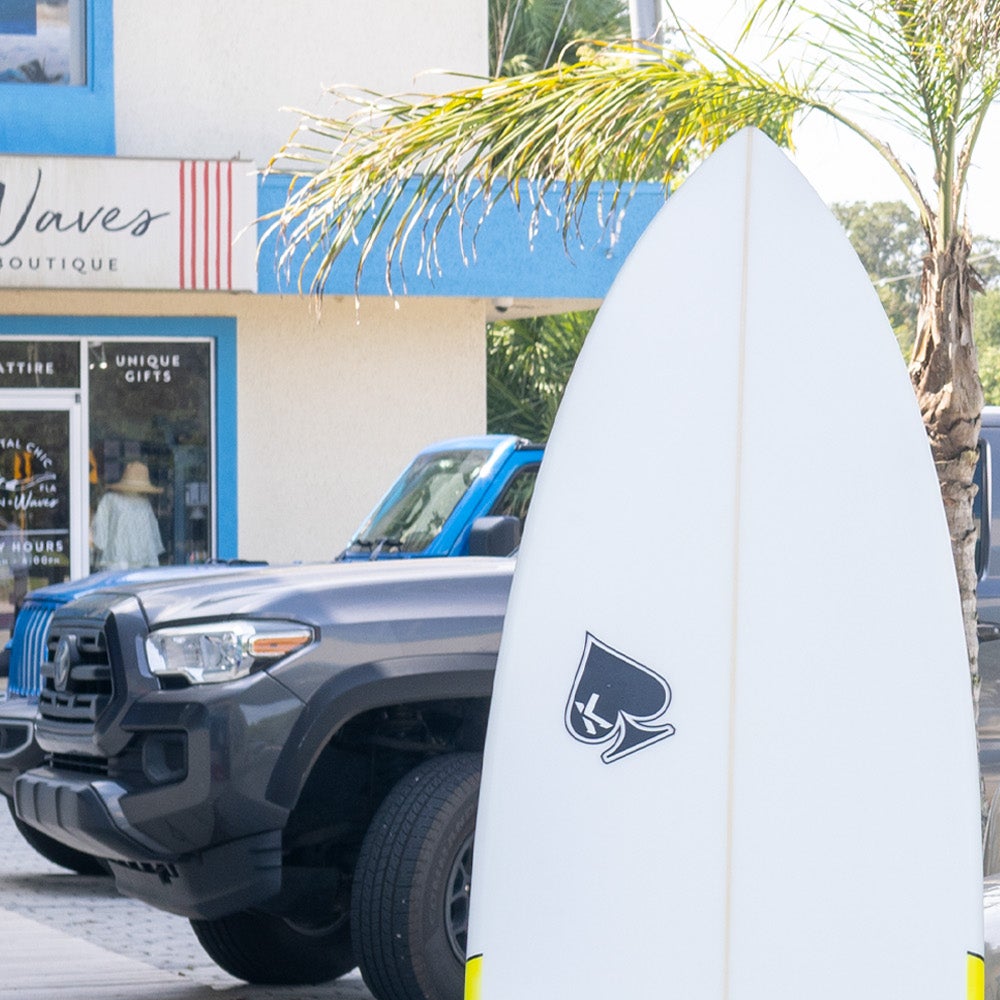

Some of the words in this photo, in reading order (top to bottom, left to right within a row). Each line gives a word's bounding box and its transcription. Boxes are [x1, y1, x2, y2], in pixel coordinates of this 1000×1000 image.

[0, 256, 118, 275] OUTIQUE
[115, 355, 181, 368] UNIQUE
[125, 371, 171, 383] GIFTS
[12, 540, 64, 553] HOURS
